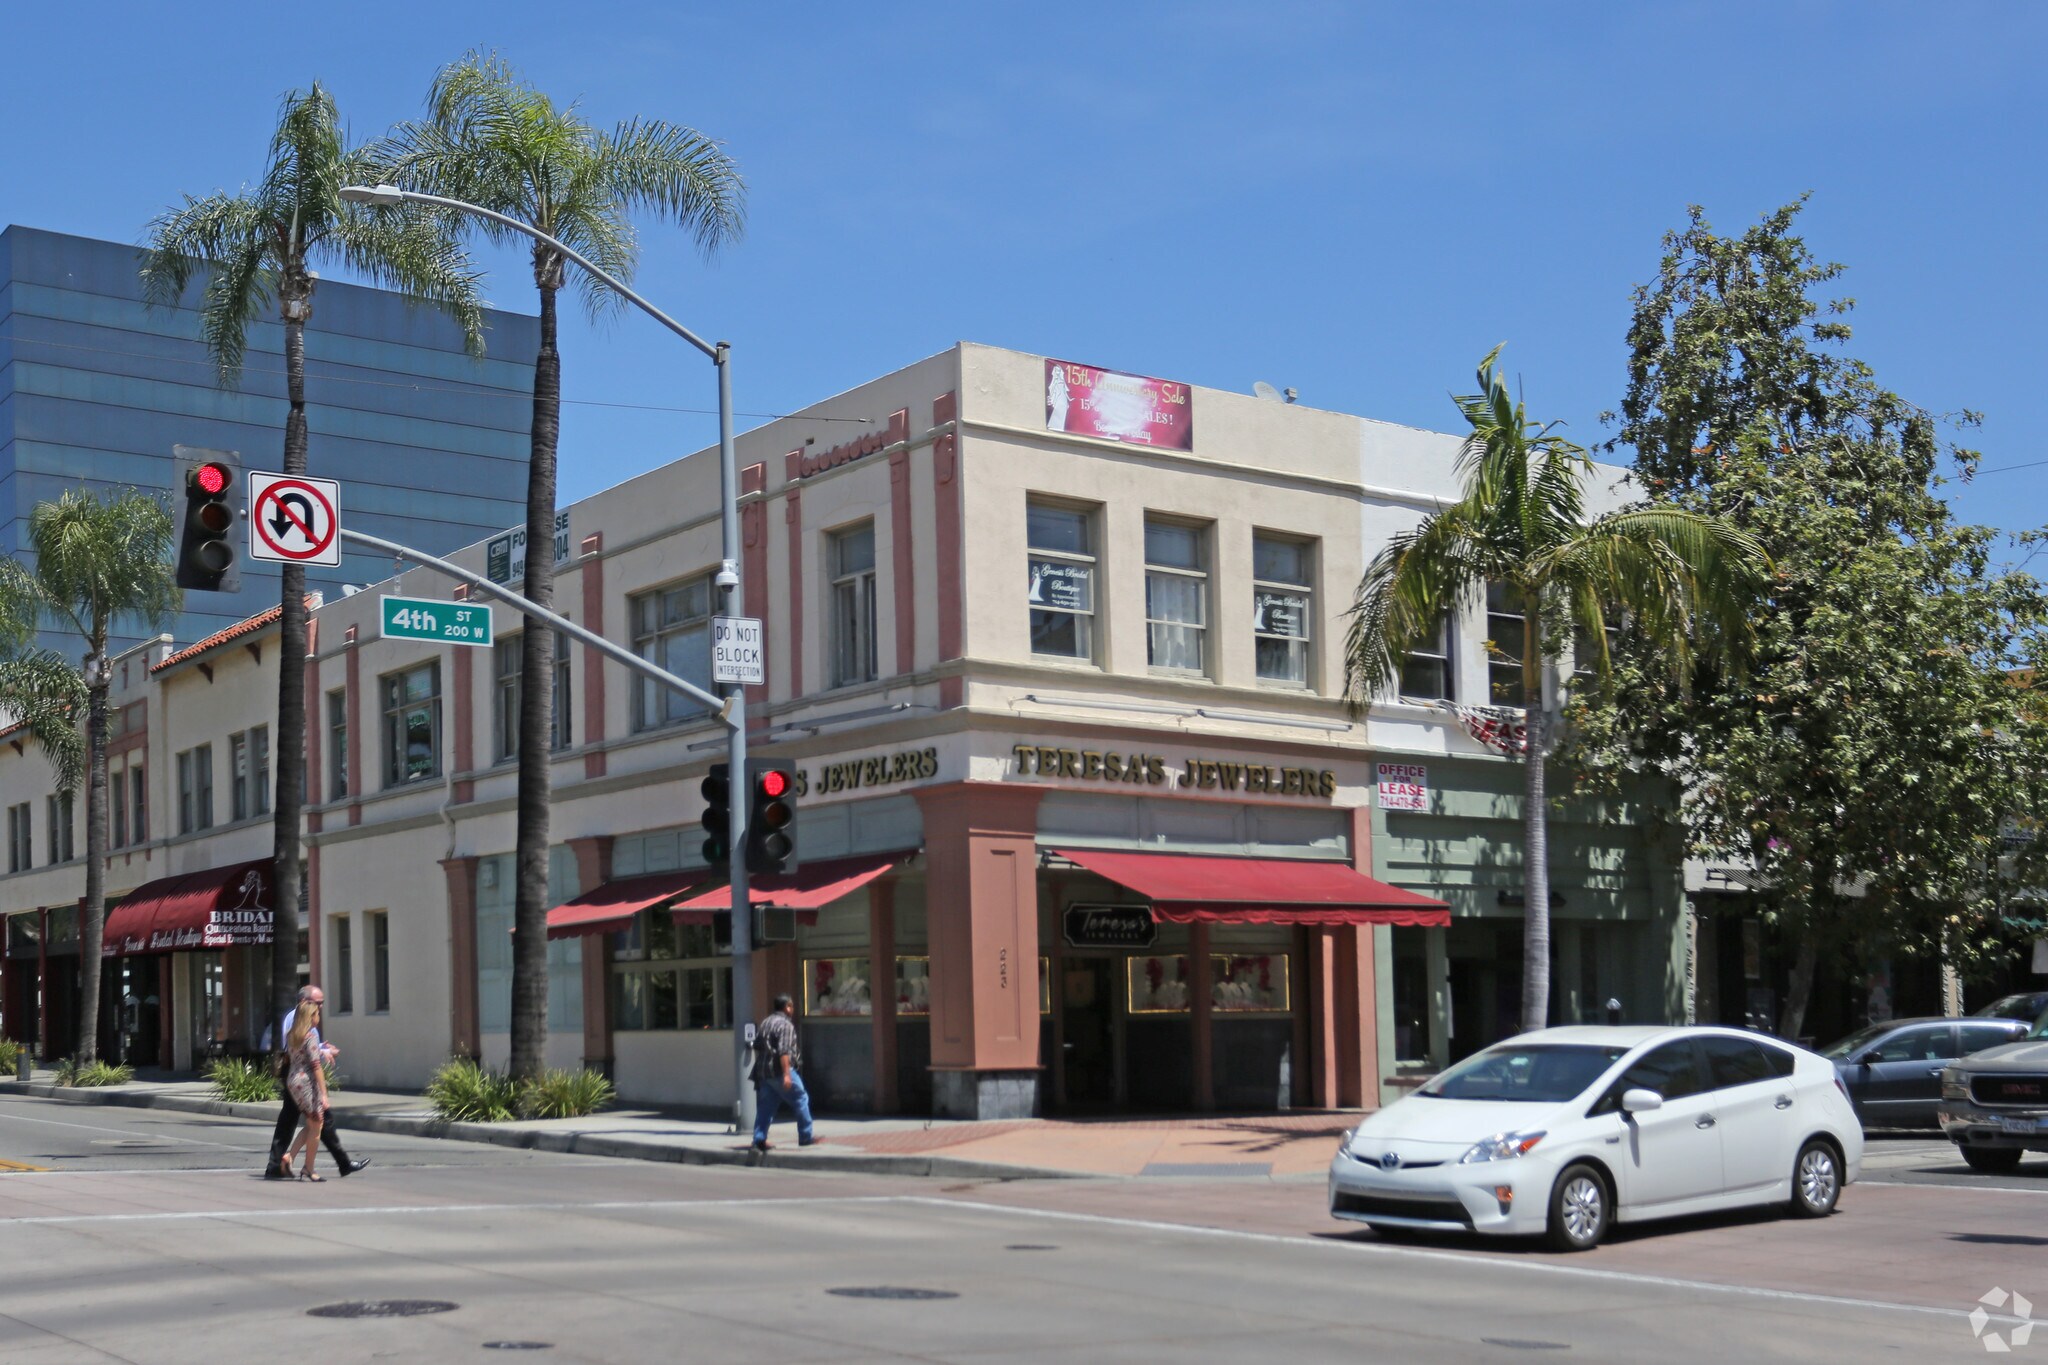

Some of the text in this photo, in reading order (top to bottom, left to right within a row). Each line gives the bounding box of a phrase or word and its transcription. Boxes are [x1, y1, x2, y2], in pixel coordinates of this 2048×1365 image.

[1065, 365, 1092, 388] 15th
[1161, 383, 1186, 405] Sale
[512, 530, 528, 549] FO
[392, 608, 472, 631] 4th ST
[444, 624, 484, 638] 200 W
[716, 626, 757, 642] DO NOT
[717, 647, 759, 663] BLOCK
[717, 665, 760, 676] INTERSECTION
[815, 747, 938, 794] JEWELERS
[1013, 744, 1337, 797] TERESA'S JEWELERS
[1378, 764, 1425, 778] OFFICE
[1393, 775, 1411, 784] FOR
[1379, 782, 1425, 797] LEASE
[1077, 908, 1147, 933] Teresa's
